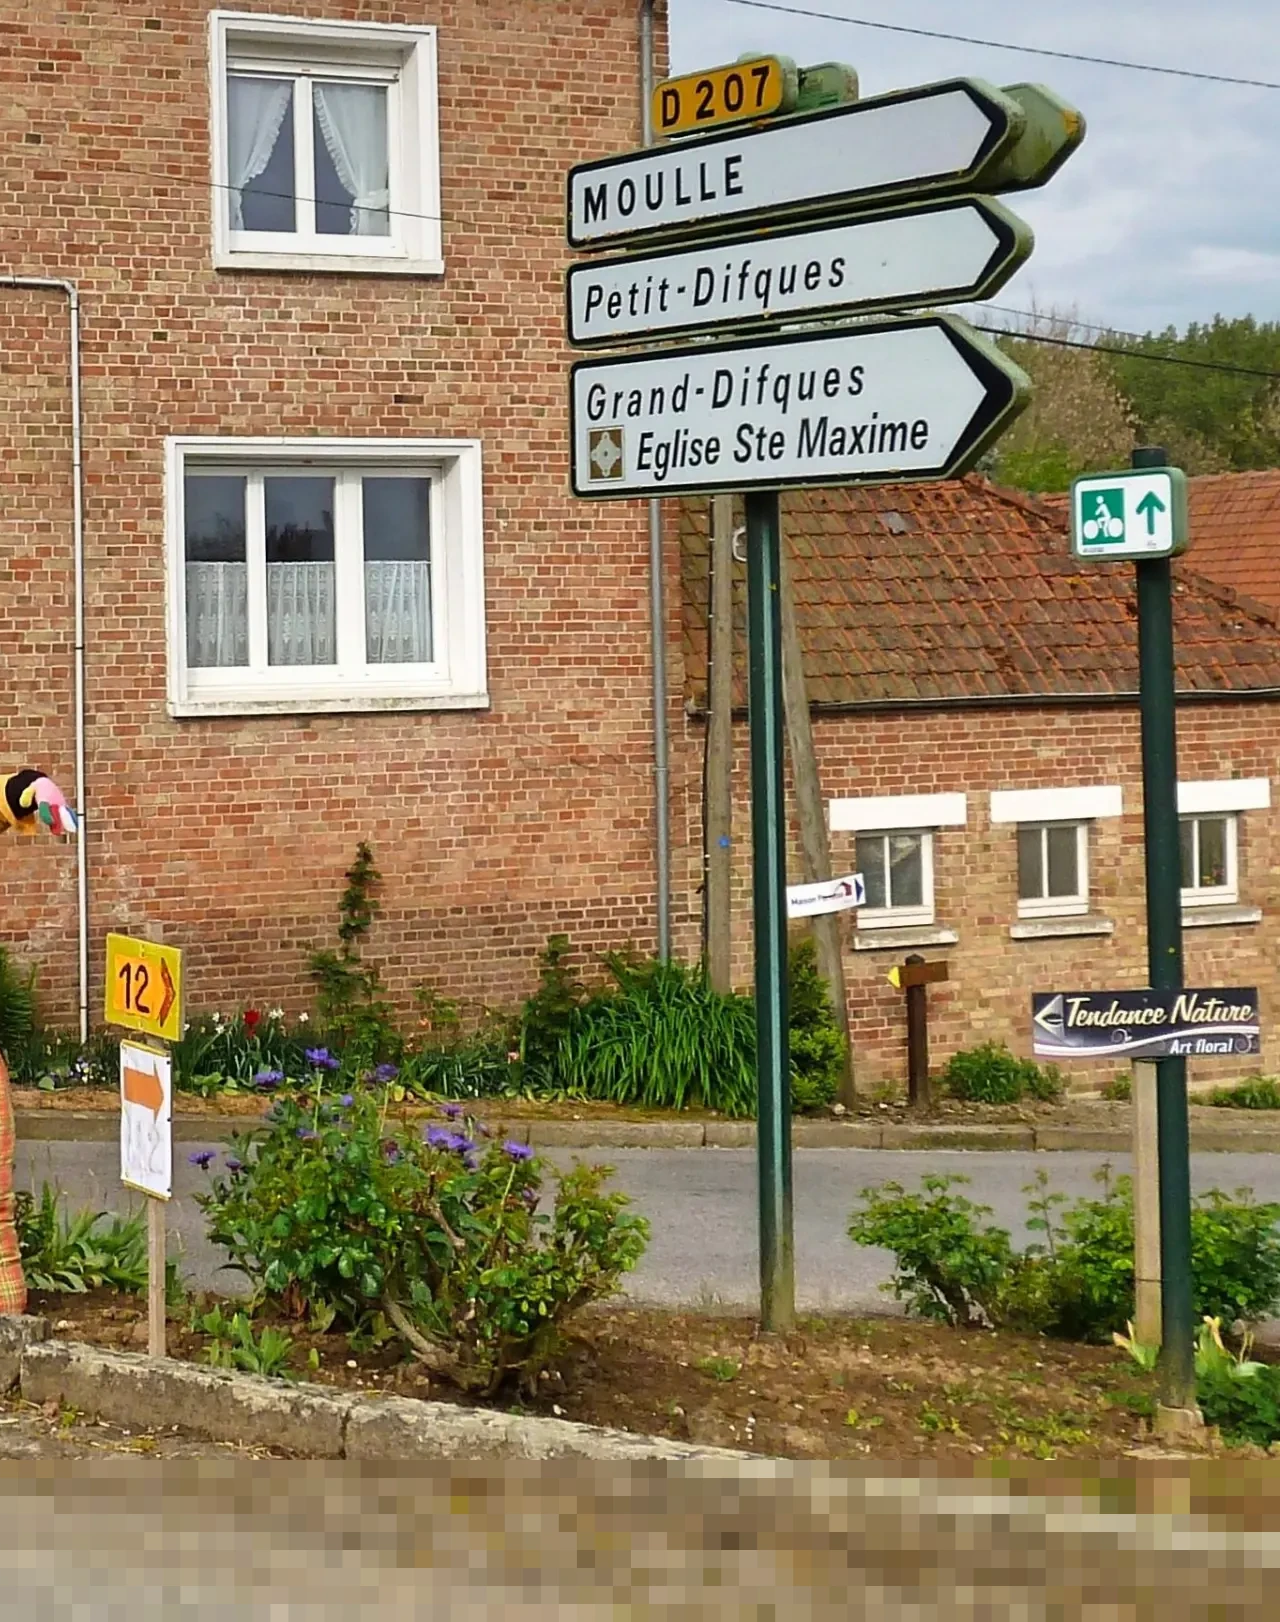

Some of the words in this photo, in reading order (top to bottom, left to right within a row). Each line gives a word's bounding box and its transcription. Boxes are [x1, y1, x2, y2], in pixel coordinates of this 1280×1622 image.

[661, 87, 681, 128] D
[694, 65, 770, 121] 207
[583, 154, 744, 224] MOULLE
[584, 257, 846, 323] Petit-Difques
[586, 362, 865, 422] Grand-Difques
[636, 427, 721, 482] Eglise
[733, 422, 786, 464] Ste
[796, 411, 930, 460] Maxime
[120, 962, 150, 1014] 12
[1065, 997, 1168, 1028] Tendance
[1170, 993, 1254, 1025] Nature
[1170, 1038, 1191, 1054] Art
[1195, 1038, 1234, 1053] floral
